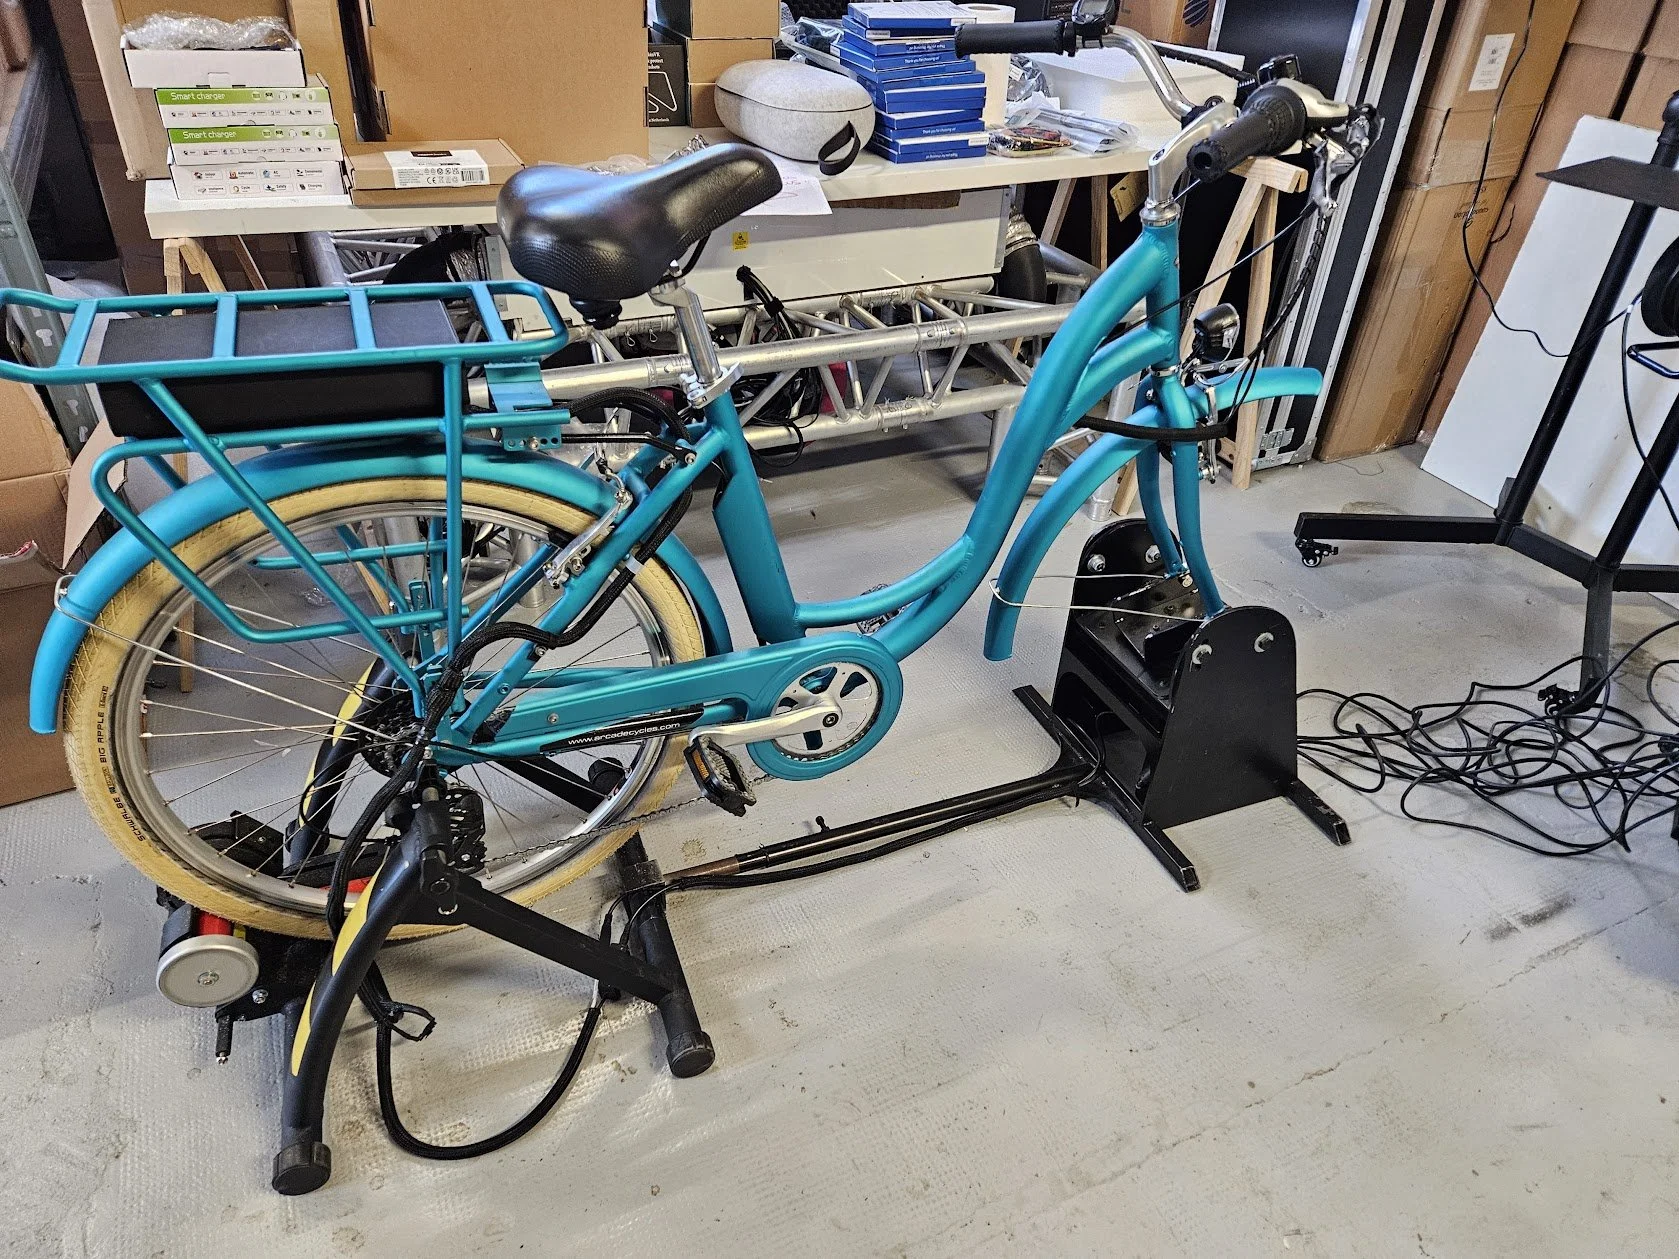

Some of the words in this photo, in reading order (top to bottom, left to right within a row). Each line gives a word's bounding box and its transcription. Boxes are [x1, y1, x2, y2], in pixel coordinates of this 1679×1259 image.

[170, 92, 195, 100] Smart
[196, 92, 226, 101] charger
[208, 131, 236, 140] charger
[568, 722, 680, 745] www.arcadecycles.com
[113, 797, 146, 842] SCHWALBE
